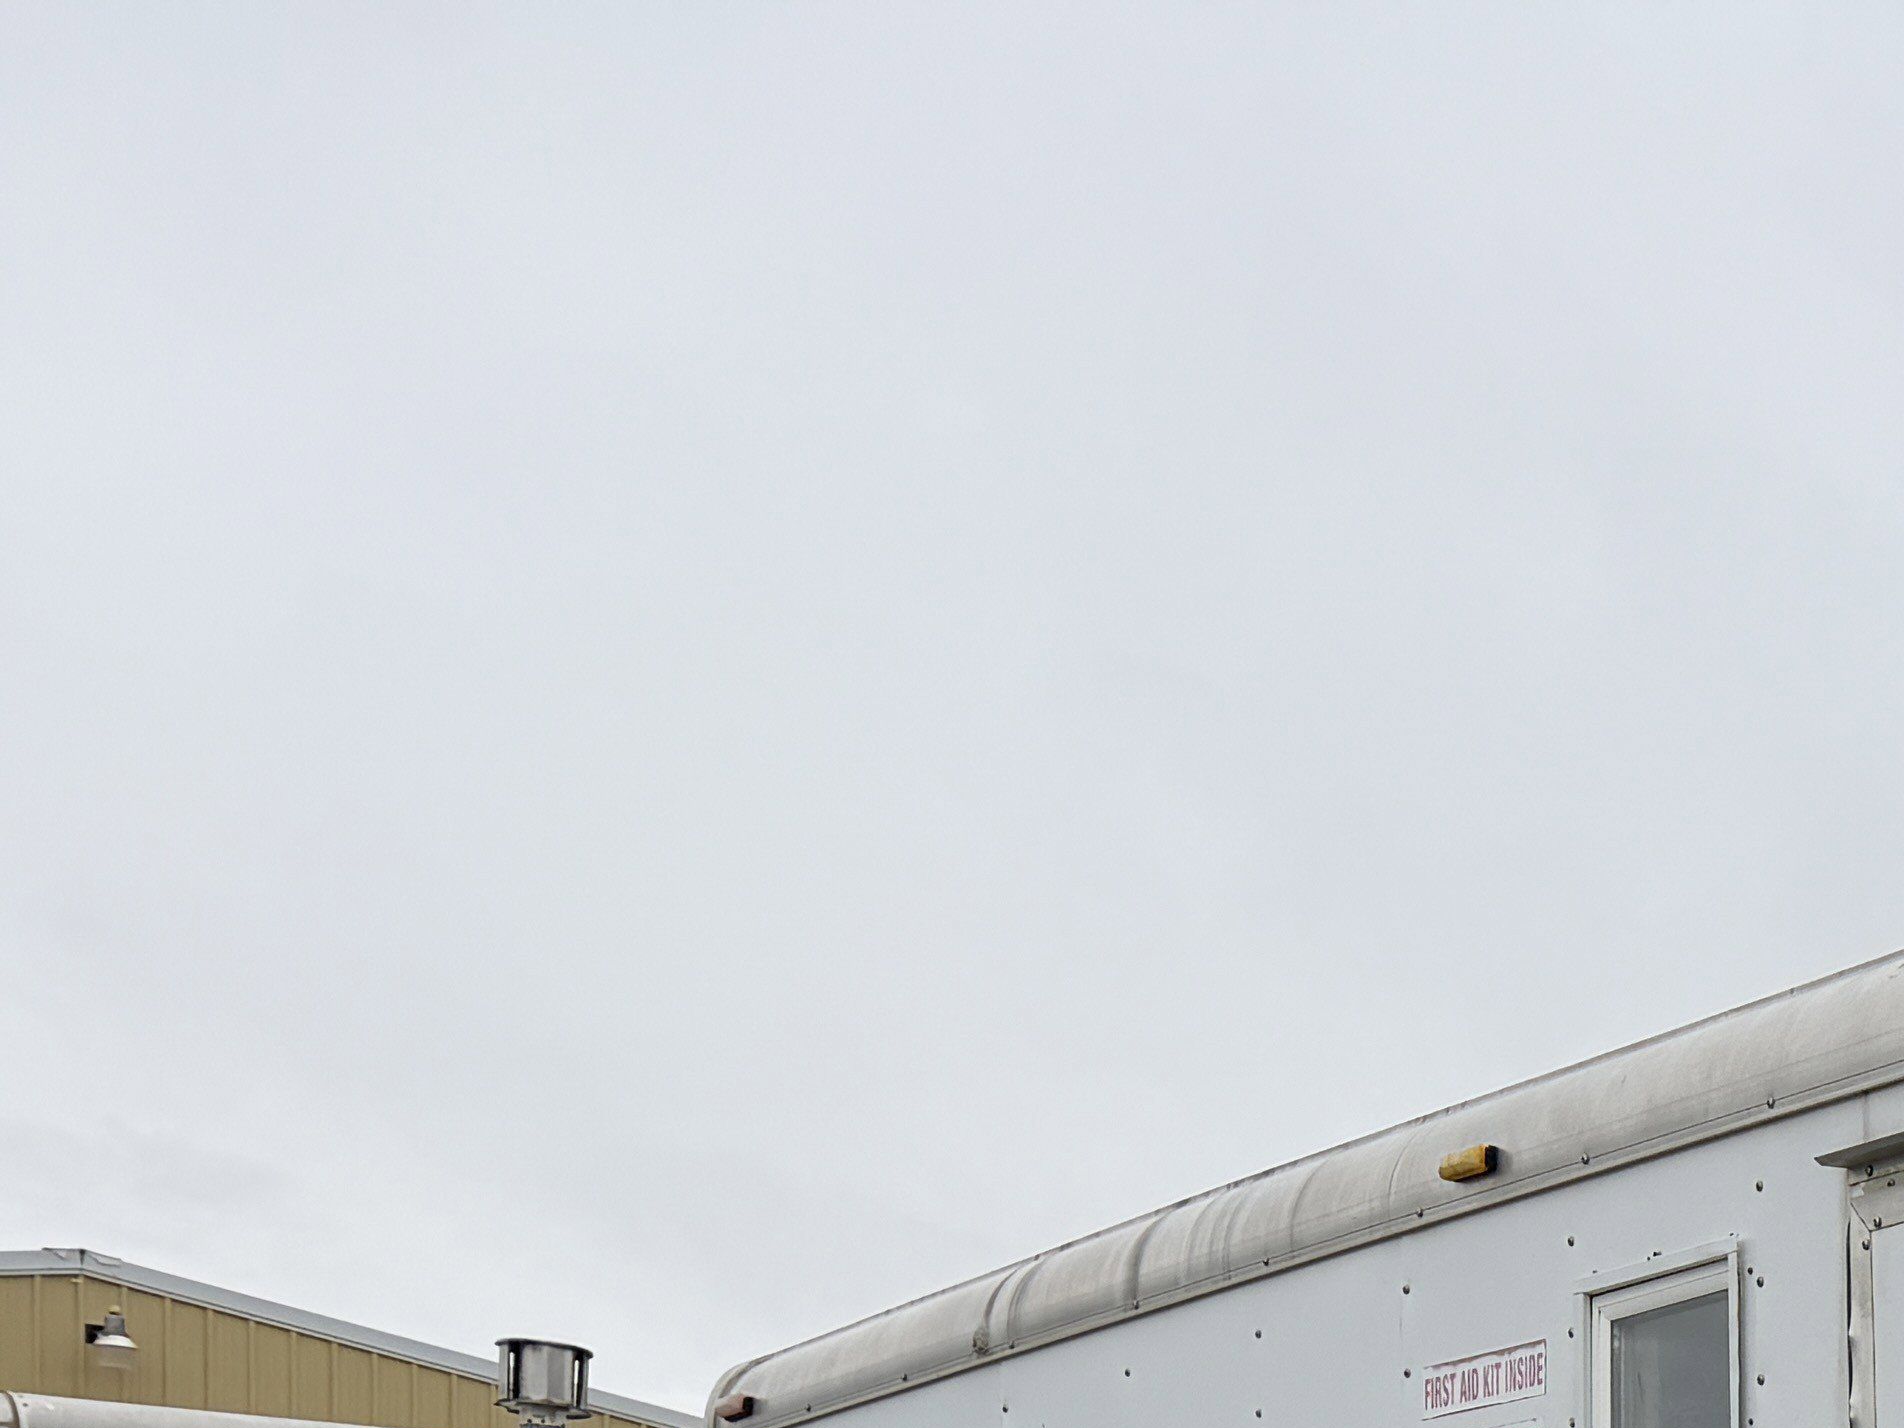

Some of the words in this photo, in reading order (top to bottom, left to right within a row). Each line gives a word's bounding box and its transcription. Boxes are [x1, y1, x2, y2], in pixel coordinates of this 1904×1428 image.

[1424, 1372, 1457, 1411] FIRST
[1459, 1367, 1480, 1404] AID
[1483, 1361, 1502, 1399] KIT
[1505, 1352, 1544, 1394] INSIDE
